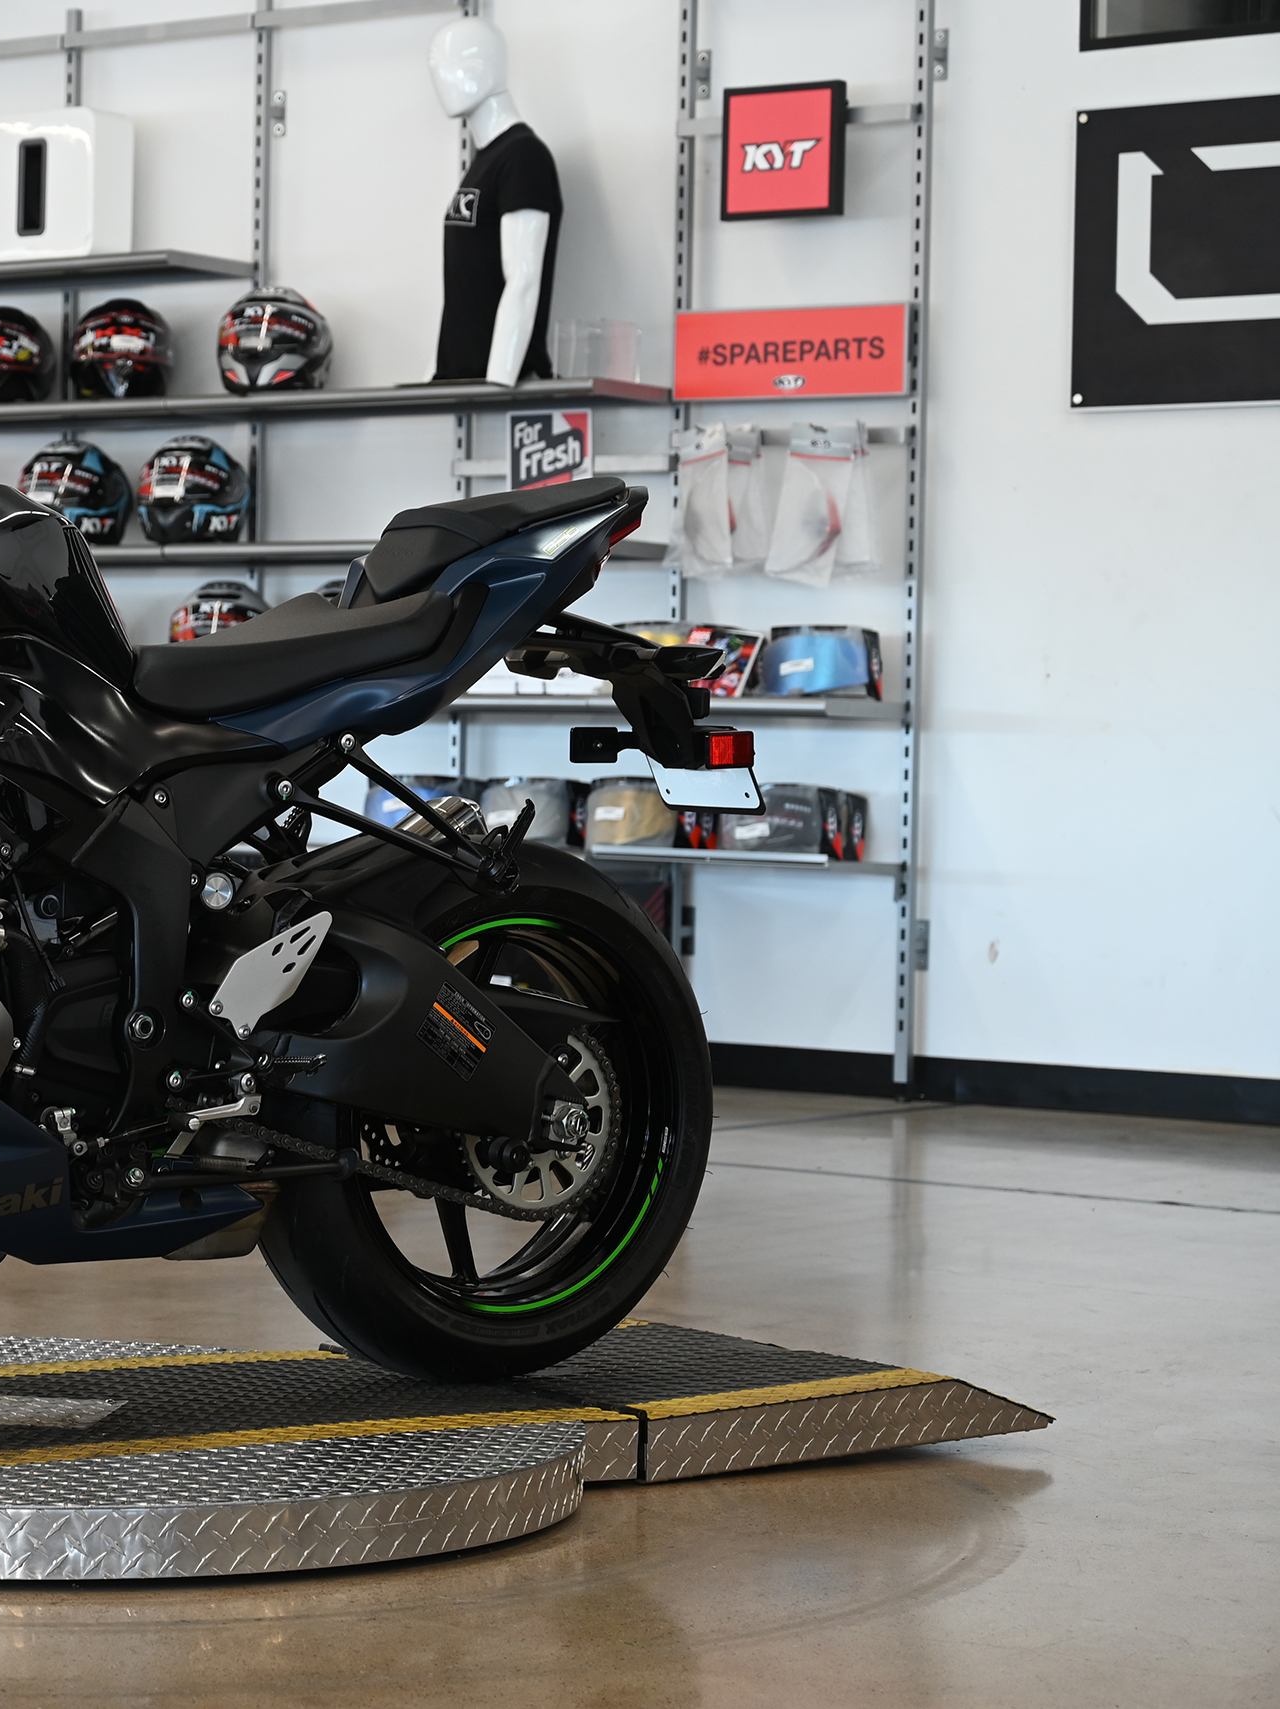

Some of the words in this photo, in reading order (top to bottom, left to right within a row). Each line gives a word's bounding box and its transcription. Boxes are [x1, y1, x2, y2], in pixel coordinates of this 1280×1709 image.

[742, 138, 821, 173] KYT
[698, 336, 885, 366] #SPAREPARTS
[514, 421, 543, 449] For
[520, 435, 581, 481] Fresh
[80, 517, 115, 534] KYT
